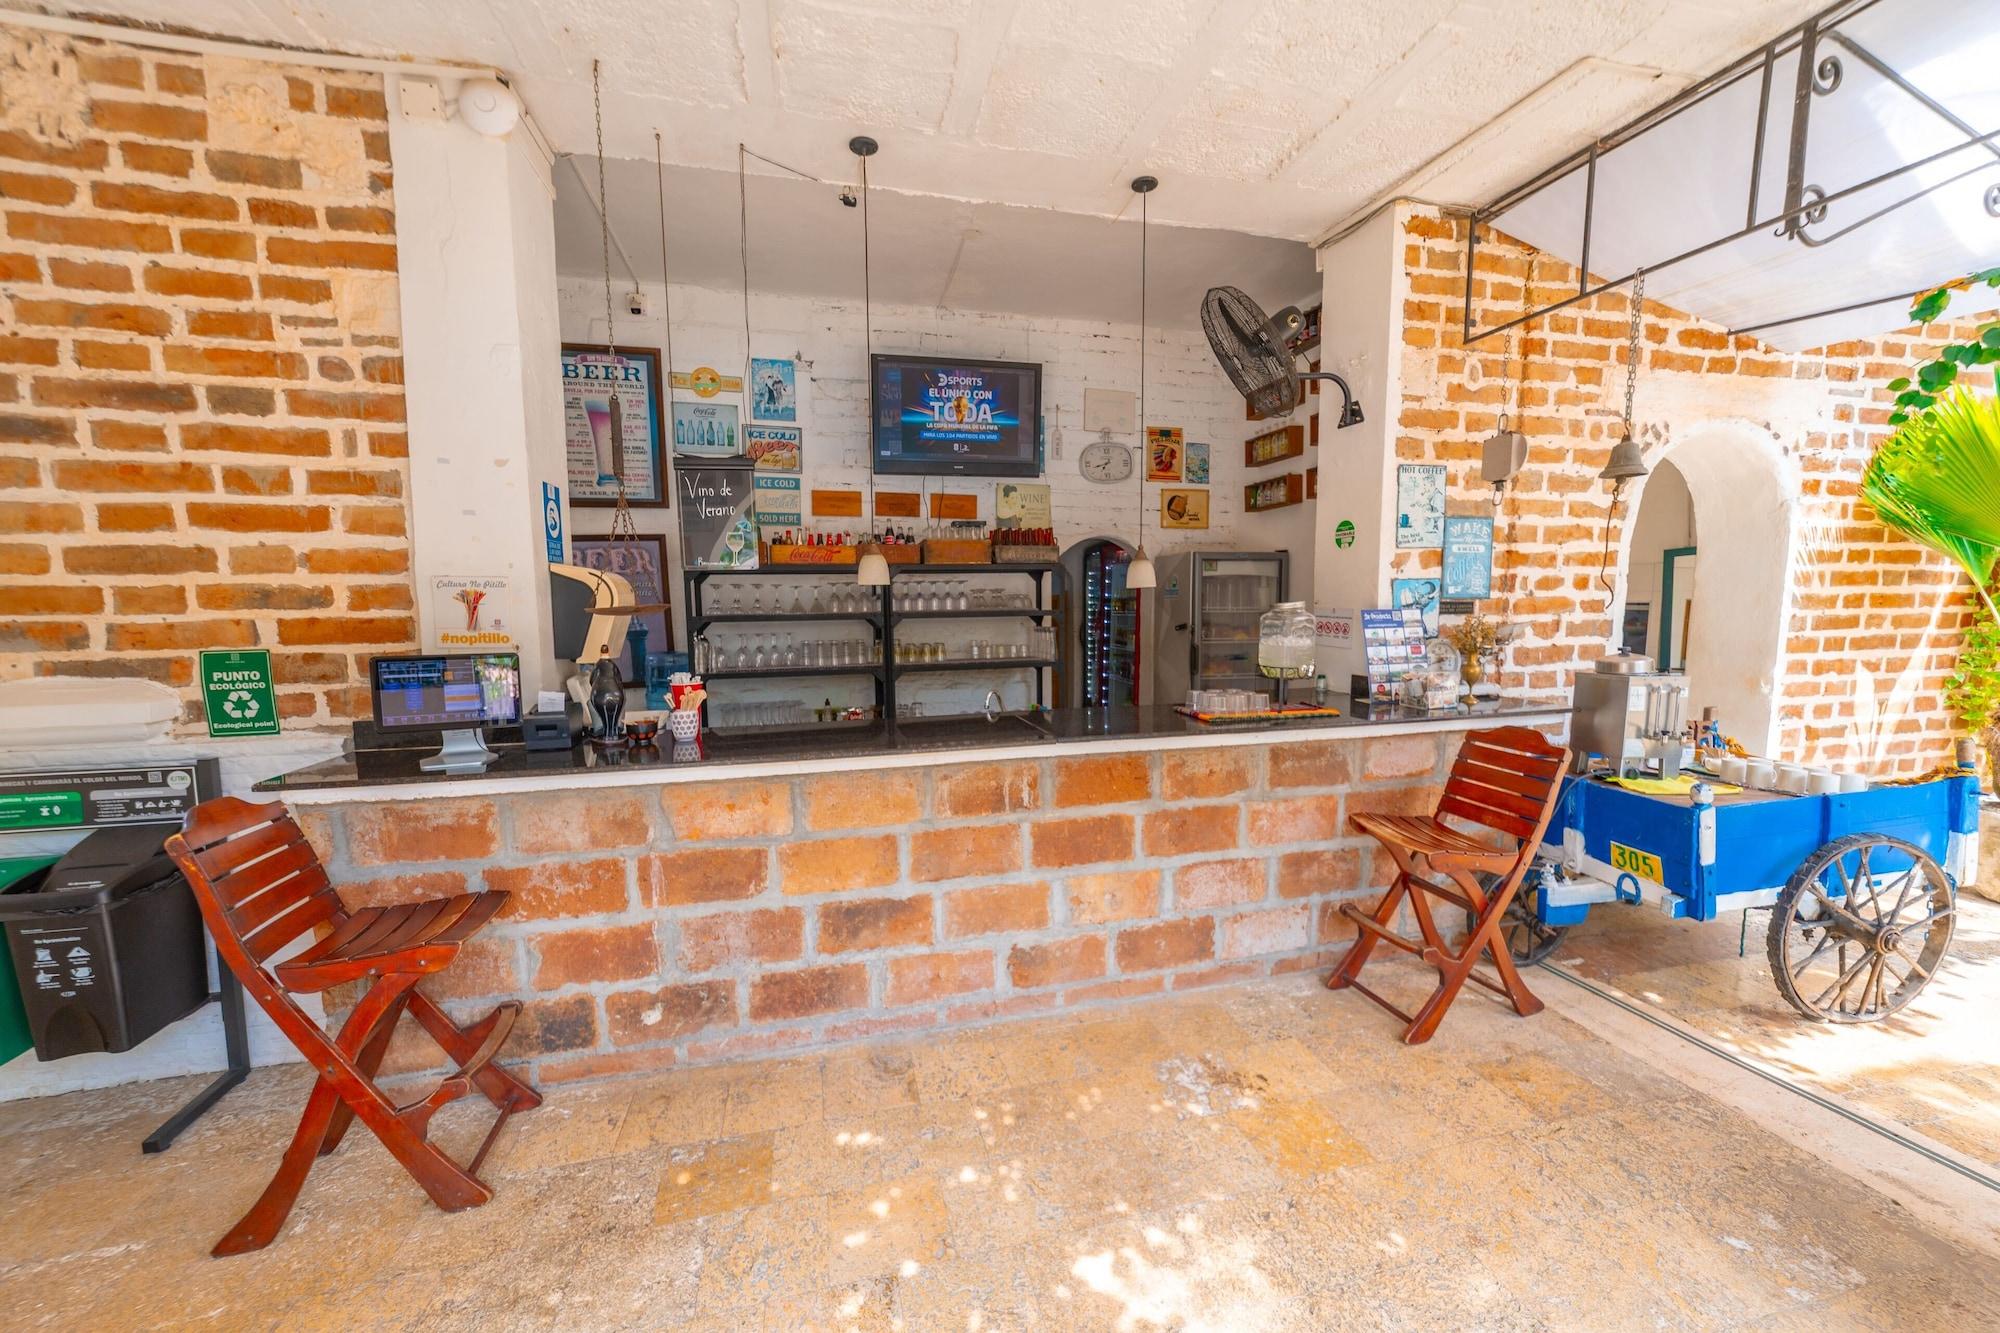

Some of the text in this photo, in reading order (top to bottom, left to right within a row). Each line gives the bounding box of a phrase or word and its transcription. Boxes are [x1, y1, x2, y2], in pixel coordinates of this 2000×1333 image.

[562, 363, 642, 382] BEER
[928, 387, 992, 400] EL ÚNICO CON
[930, 402, 992, 424] TODA
[747, 430, 796, 440] ICE COLD
[1418, 467, 1443, 475] COFFEE
[684, 473, 733, 498] Vino de
[774, 480, 796, 488] COLD
[696, 498, 736, 519] Verano
[1450, 521, 1490, 538] WAKE
[436, 580, 507, 589] Cultura No Pitillo
[441, 632, 510, 646] #nopitillo
[212, 671, 260, 682] PUNTO
[209, 681, 266, 690] ECOLÓGICO
[213, 721, 254, 729] Ecological
[1616, 844, 1654, 876] 305
